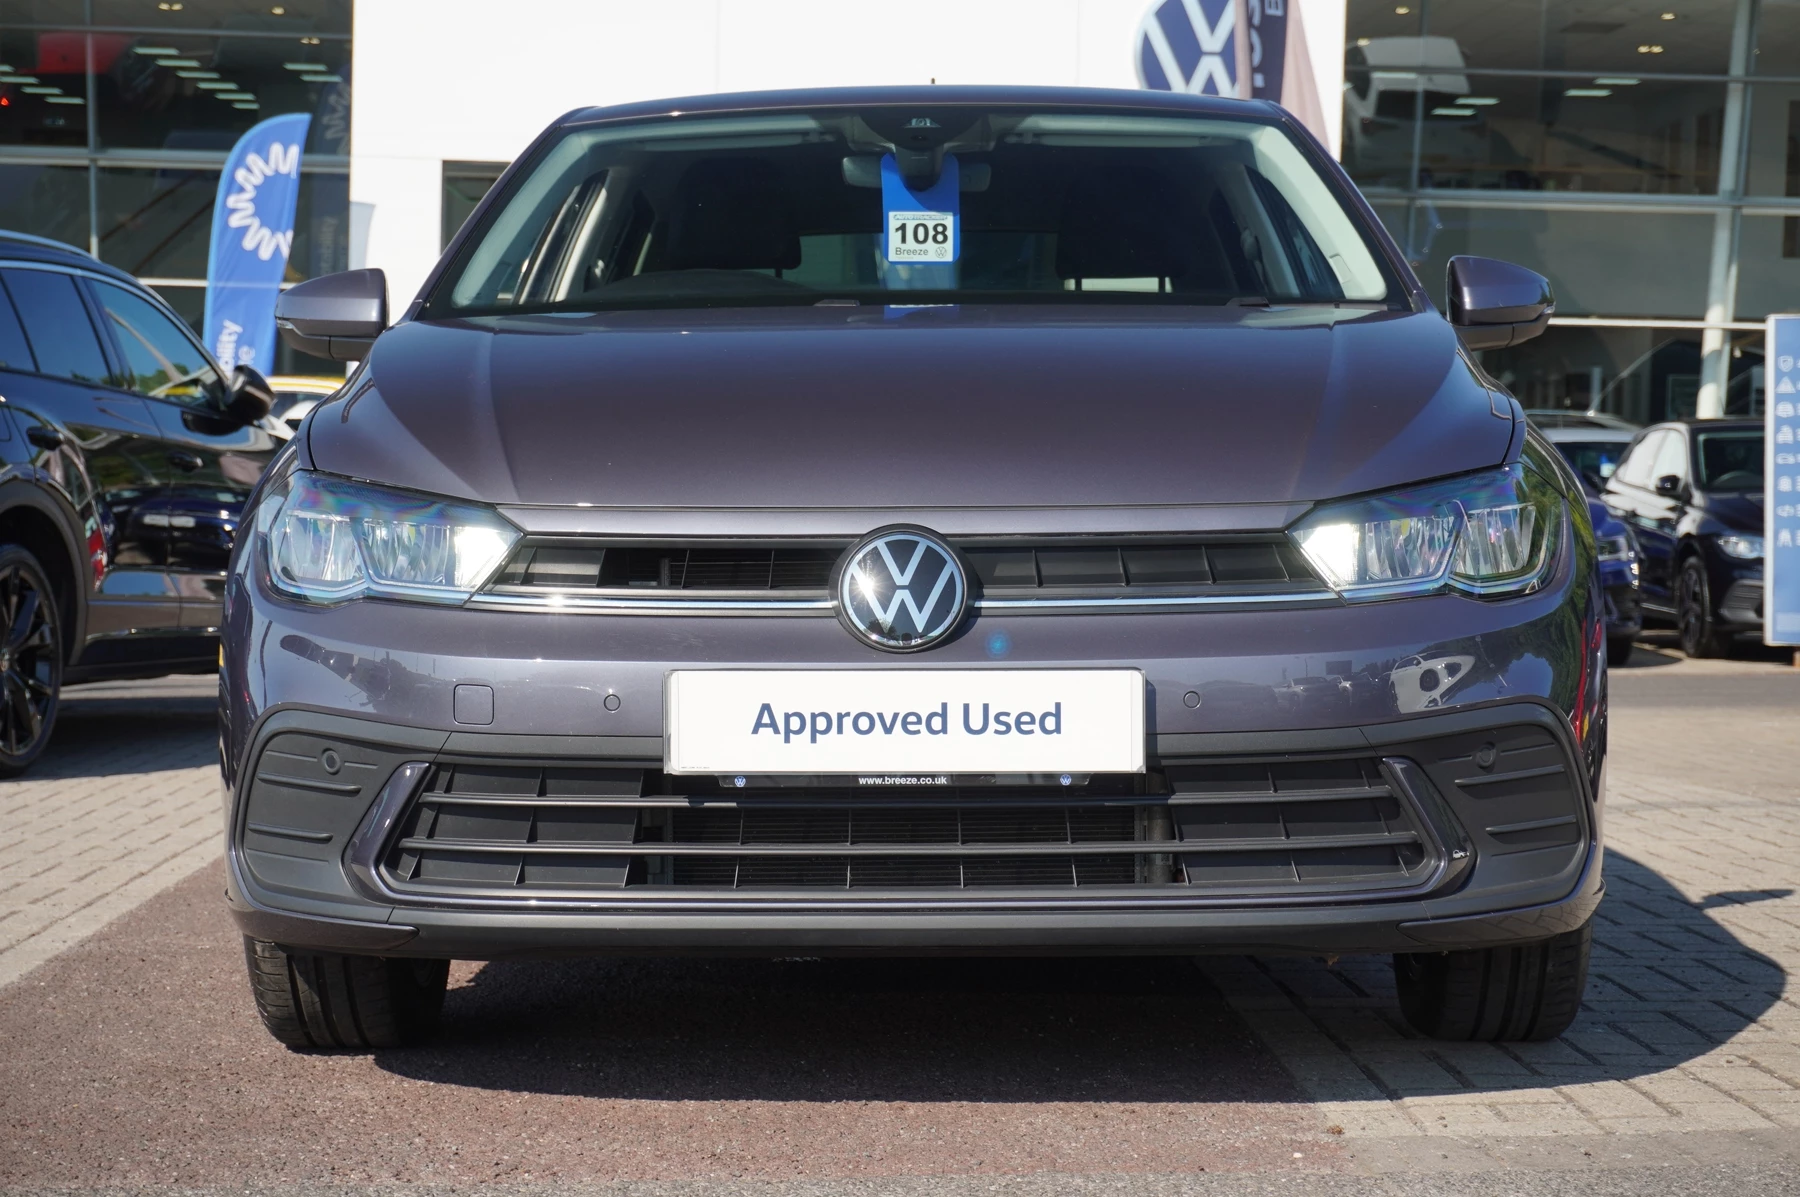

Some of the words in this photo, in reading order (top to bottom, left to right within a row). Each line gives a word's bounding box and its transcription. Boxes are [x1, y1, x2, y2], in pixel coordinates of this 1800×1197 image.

[895, 222, 949, 245] 108
[895, 247, 929, 256] Breeze
[843, 533, 962, 647] VW
[751, 702, 948, 744] Approved
[962, 702, 1061, 735] Used
[858, 775, 947, 785] www.breeze.co.uk
